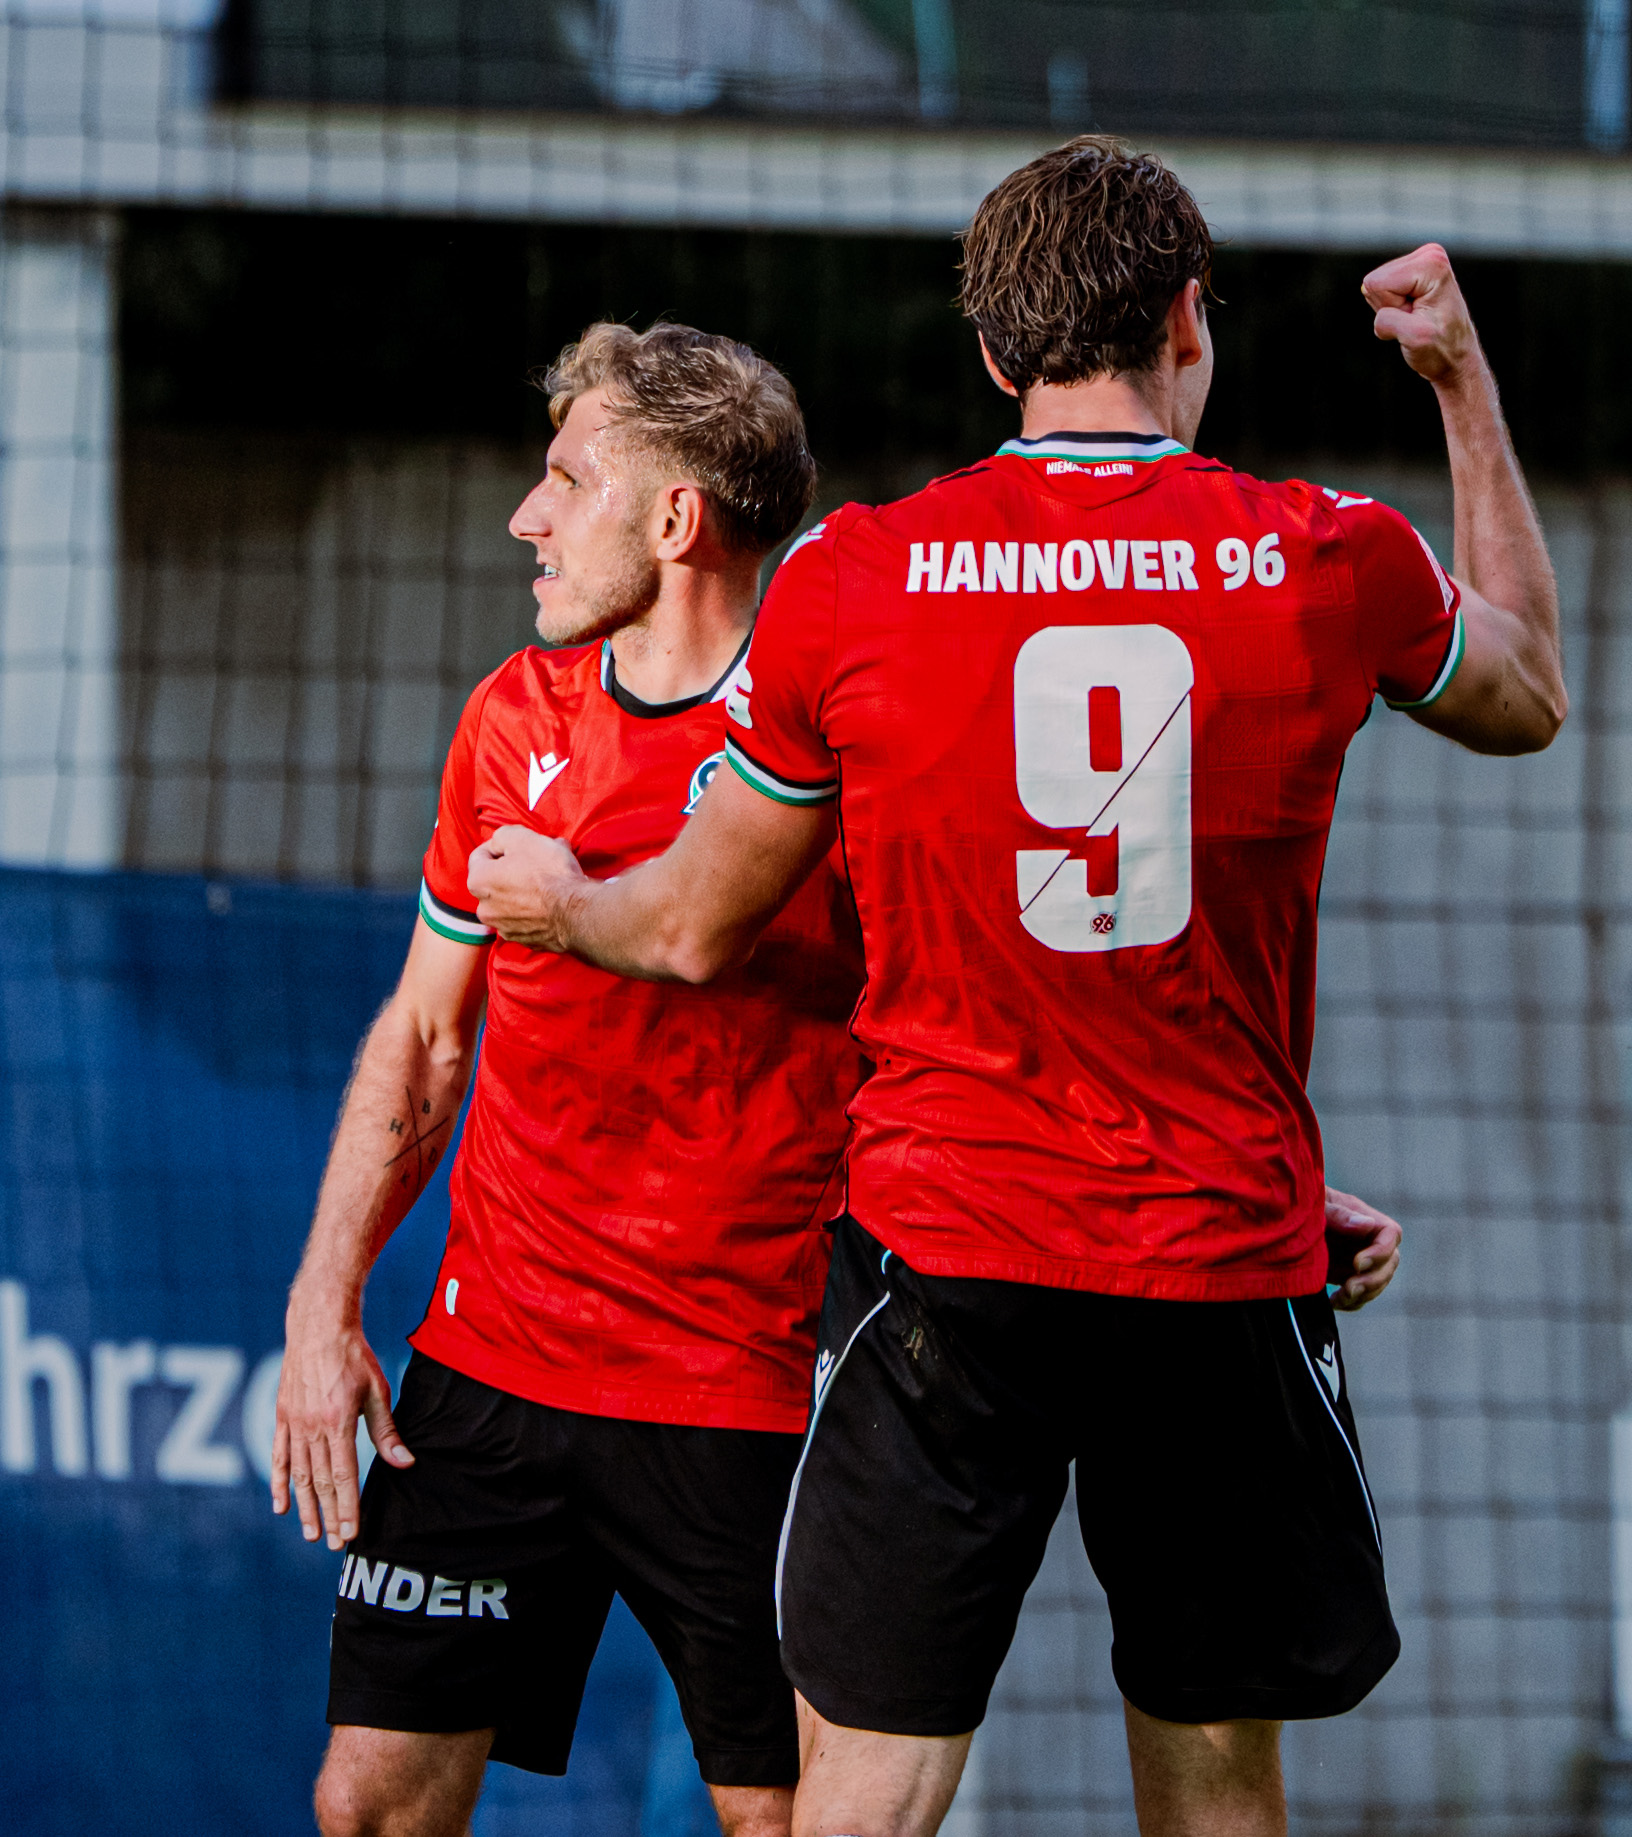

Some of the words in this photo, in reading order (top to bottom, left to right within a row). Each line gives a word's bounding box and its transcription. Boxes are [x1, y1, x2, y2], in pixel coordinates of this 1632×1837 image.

[905, 539, 1199, 593] HANNOVER
[1215, 532, 1286, 591] 96
[1013, 624, 1194, 952] 9
[1092, 914, 1115, 933] 96
[338, 1553, 510, 1620] INDER
